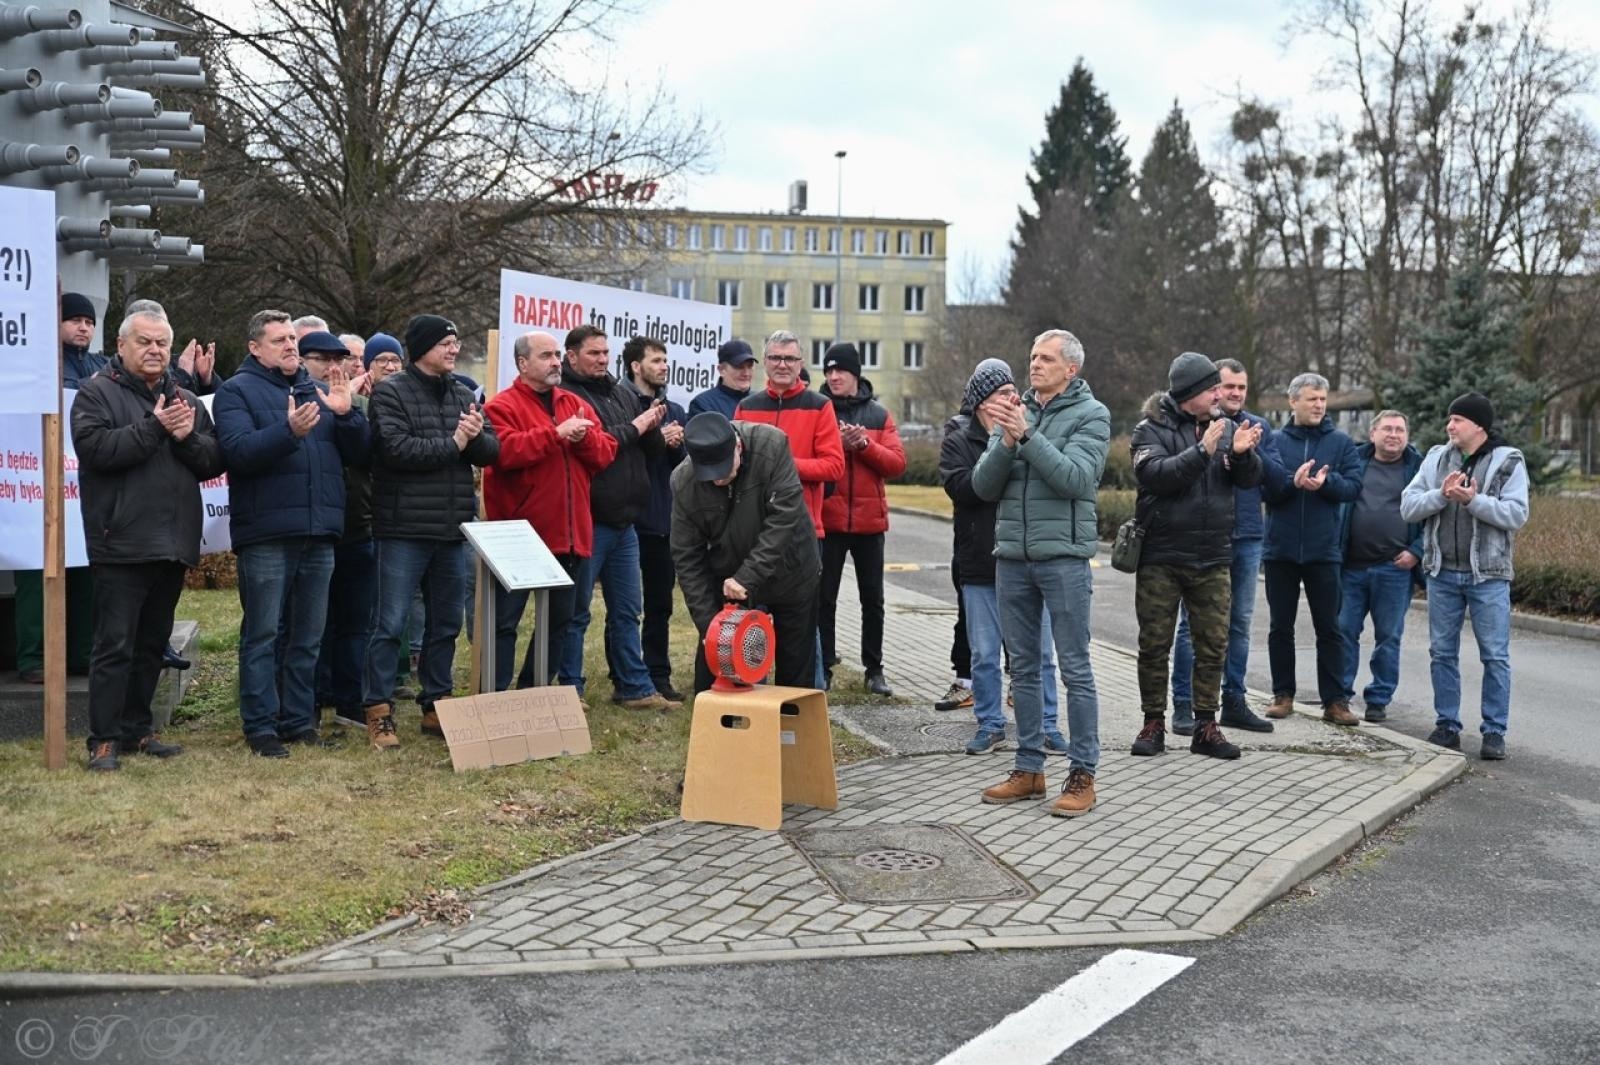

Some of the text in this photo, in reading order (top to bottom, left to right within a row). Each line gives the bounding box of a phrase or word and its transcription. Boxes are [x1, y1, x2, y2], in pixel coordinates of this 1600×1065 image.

[514, 294, 723, 354] RAFAKO to nie ideologia!
[7, 449, 38, 475] będzie
